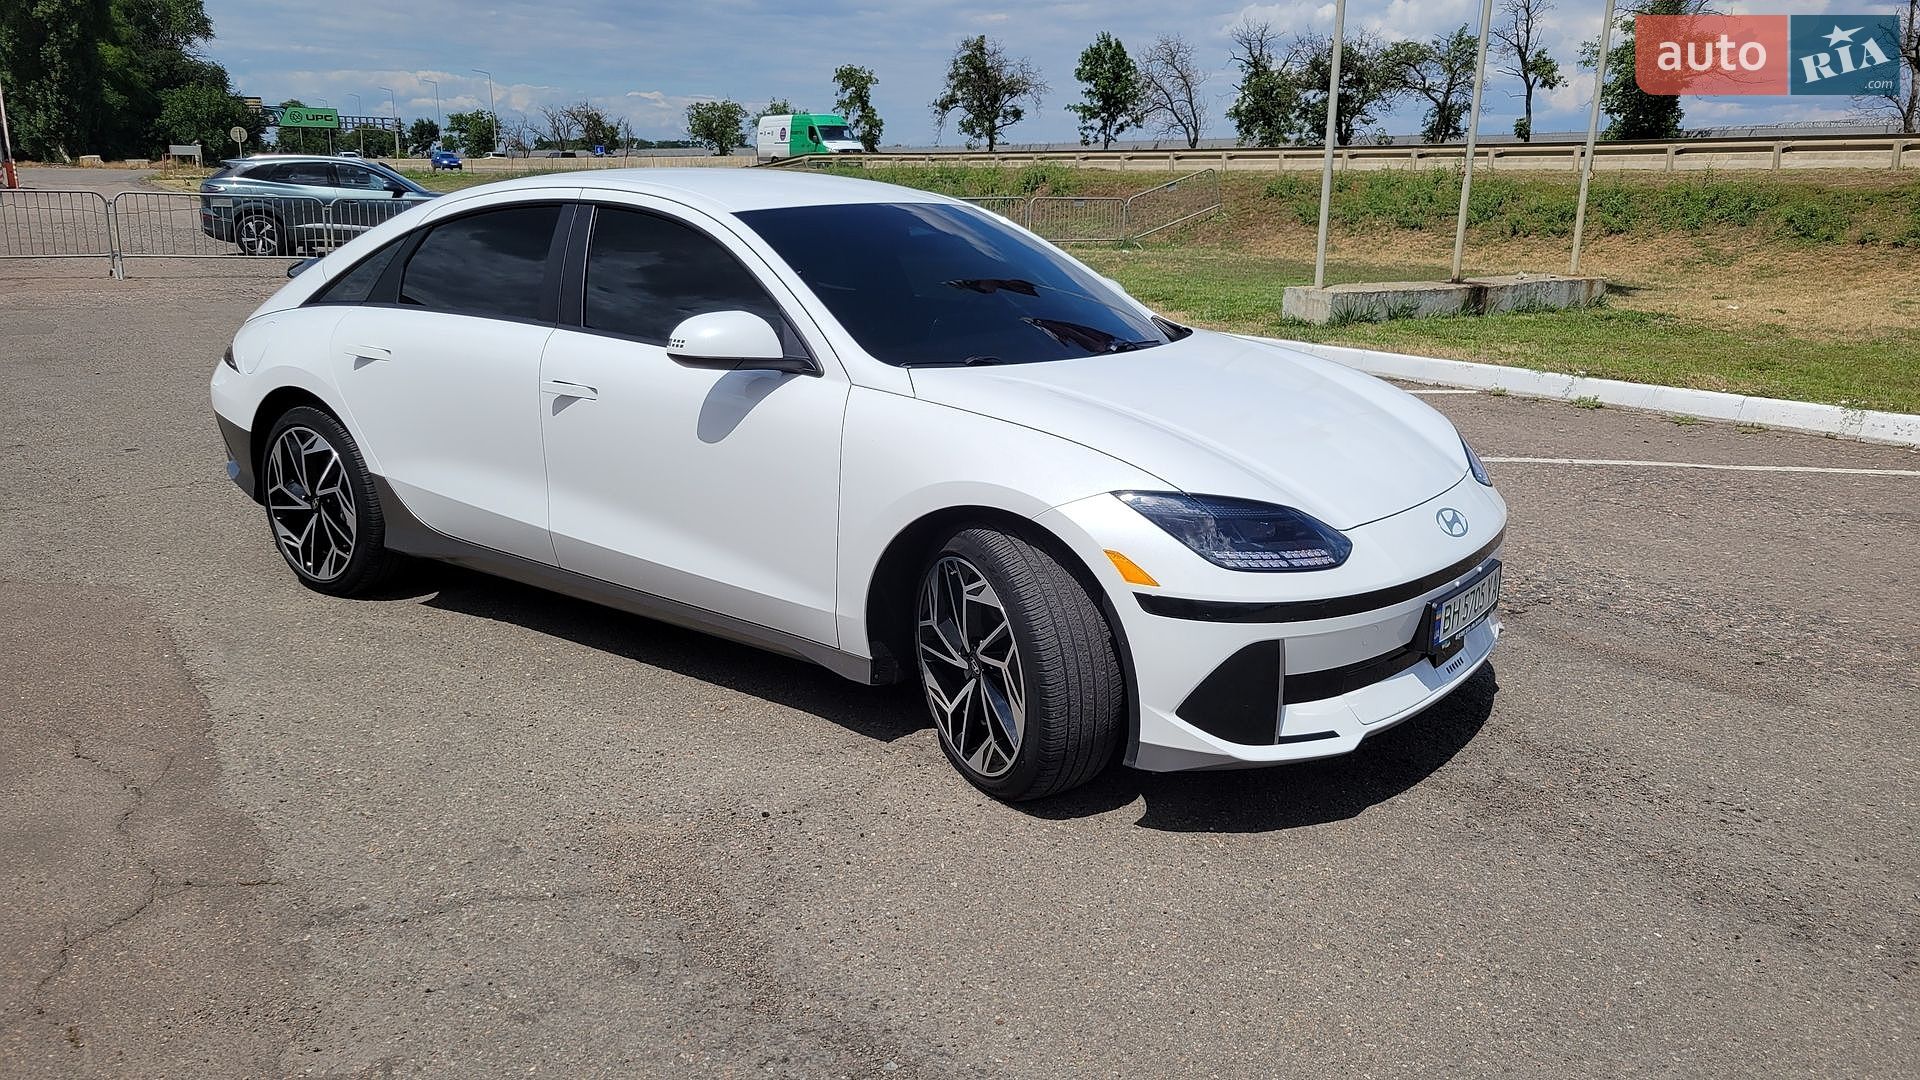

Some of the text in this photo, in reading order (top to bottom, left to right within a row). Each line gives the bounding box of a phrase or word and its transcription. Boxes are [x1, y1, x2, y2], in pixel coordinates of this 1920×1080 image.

[305, 114, 334, 122] UPG
[1442, 598, 1461, 634] BH
[1462, 581, 1486, 621] 5705
